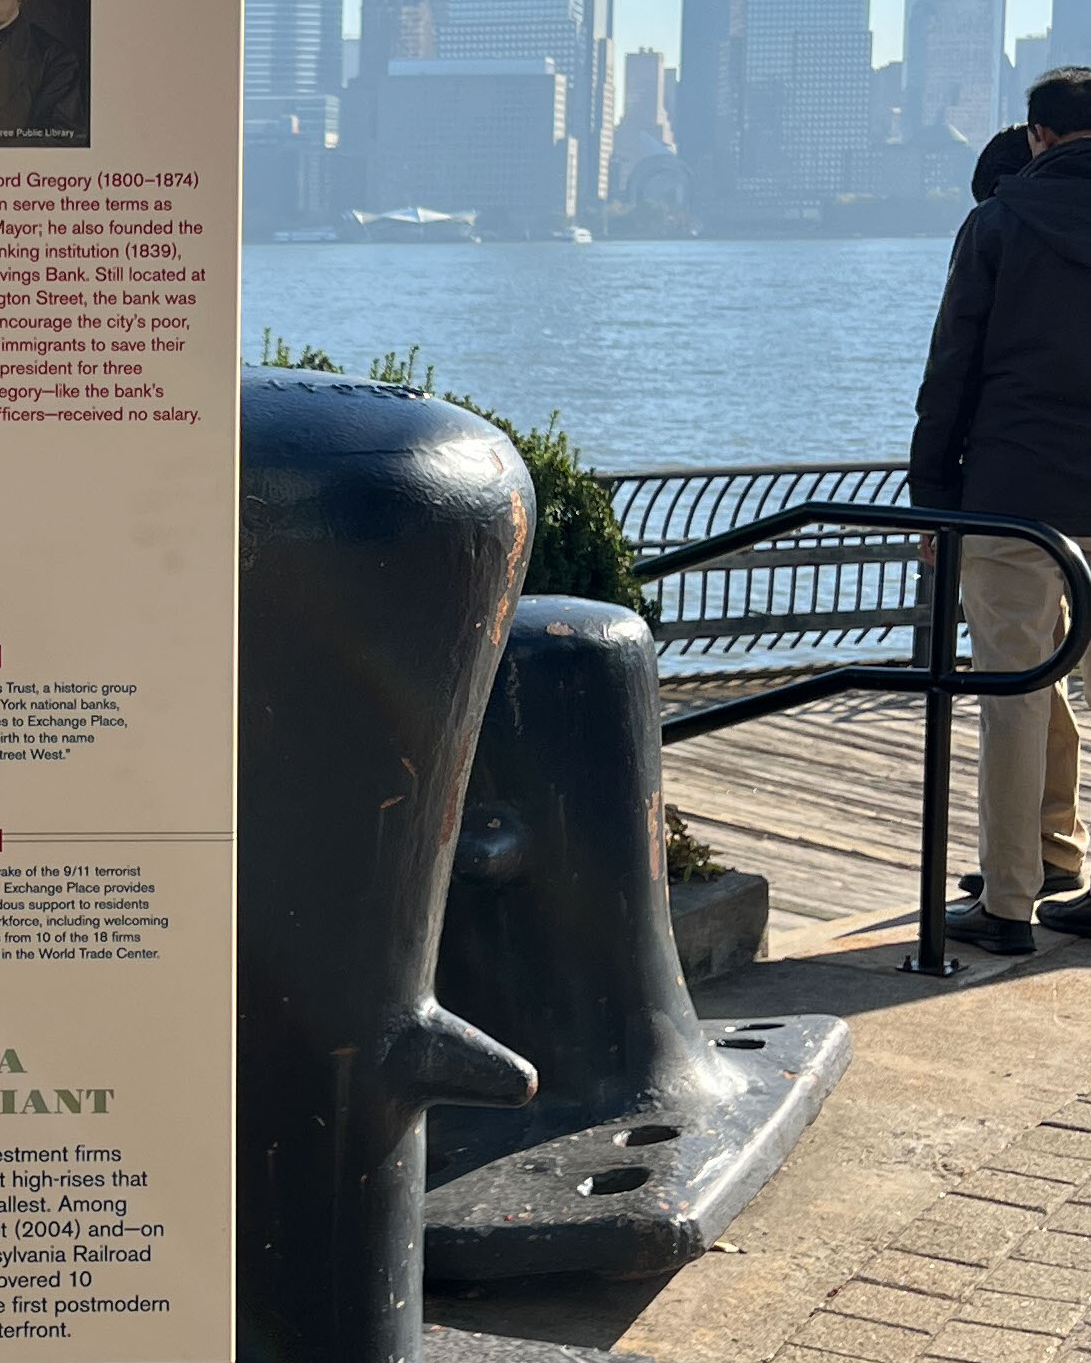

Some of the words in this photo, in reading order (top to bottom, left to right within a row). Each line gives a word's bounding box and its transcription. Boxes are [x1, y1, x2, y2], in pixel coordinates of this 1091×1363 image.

[16, 128, 42, 137] Public
[45, 129, 74, 138] Library
[27, 172, 91, 191] Gregory
[13, 201, 54, 211] serve
[61, 197, 100, 211] three
[106, 198, 148, 211] terms
[154, 200, 172, 211] as
[48, 220, 66, 234] he
[72, 220, 103, 234] also
[109, 220, 172, 234] founded
[179, 220, 202, 234] the
[6, 682, 39, 695] Trust,
[43, 685, 50, 693] a
[54, 682, 97, 693] historic
[102, 685, 136, 696] group
[0, 699, 27, 710] York
[31, 699, 76, 709] national
[81, 699, 119, 711] banks,
[26, 866, 36, 877] of
[41, 866, 59, 876] the
[64, 866, 88, 876] 9/11
[95, 866, 140, 876] terrorist
[75, 1145, 121, 1161] firms
